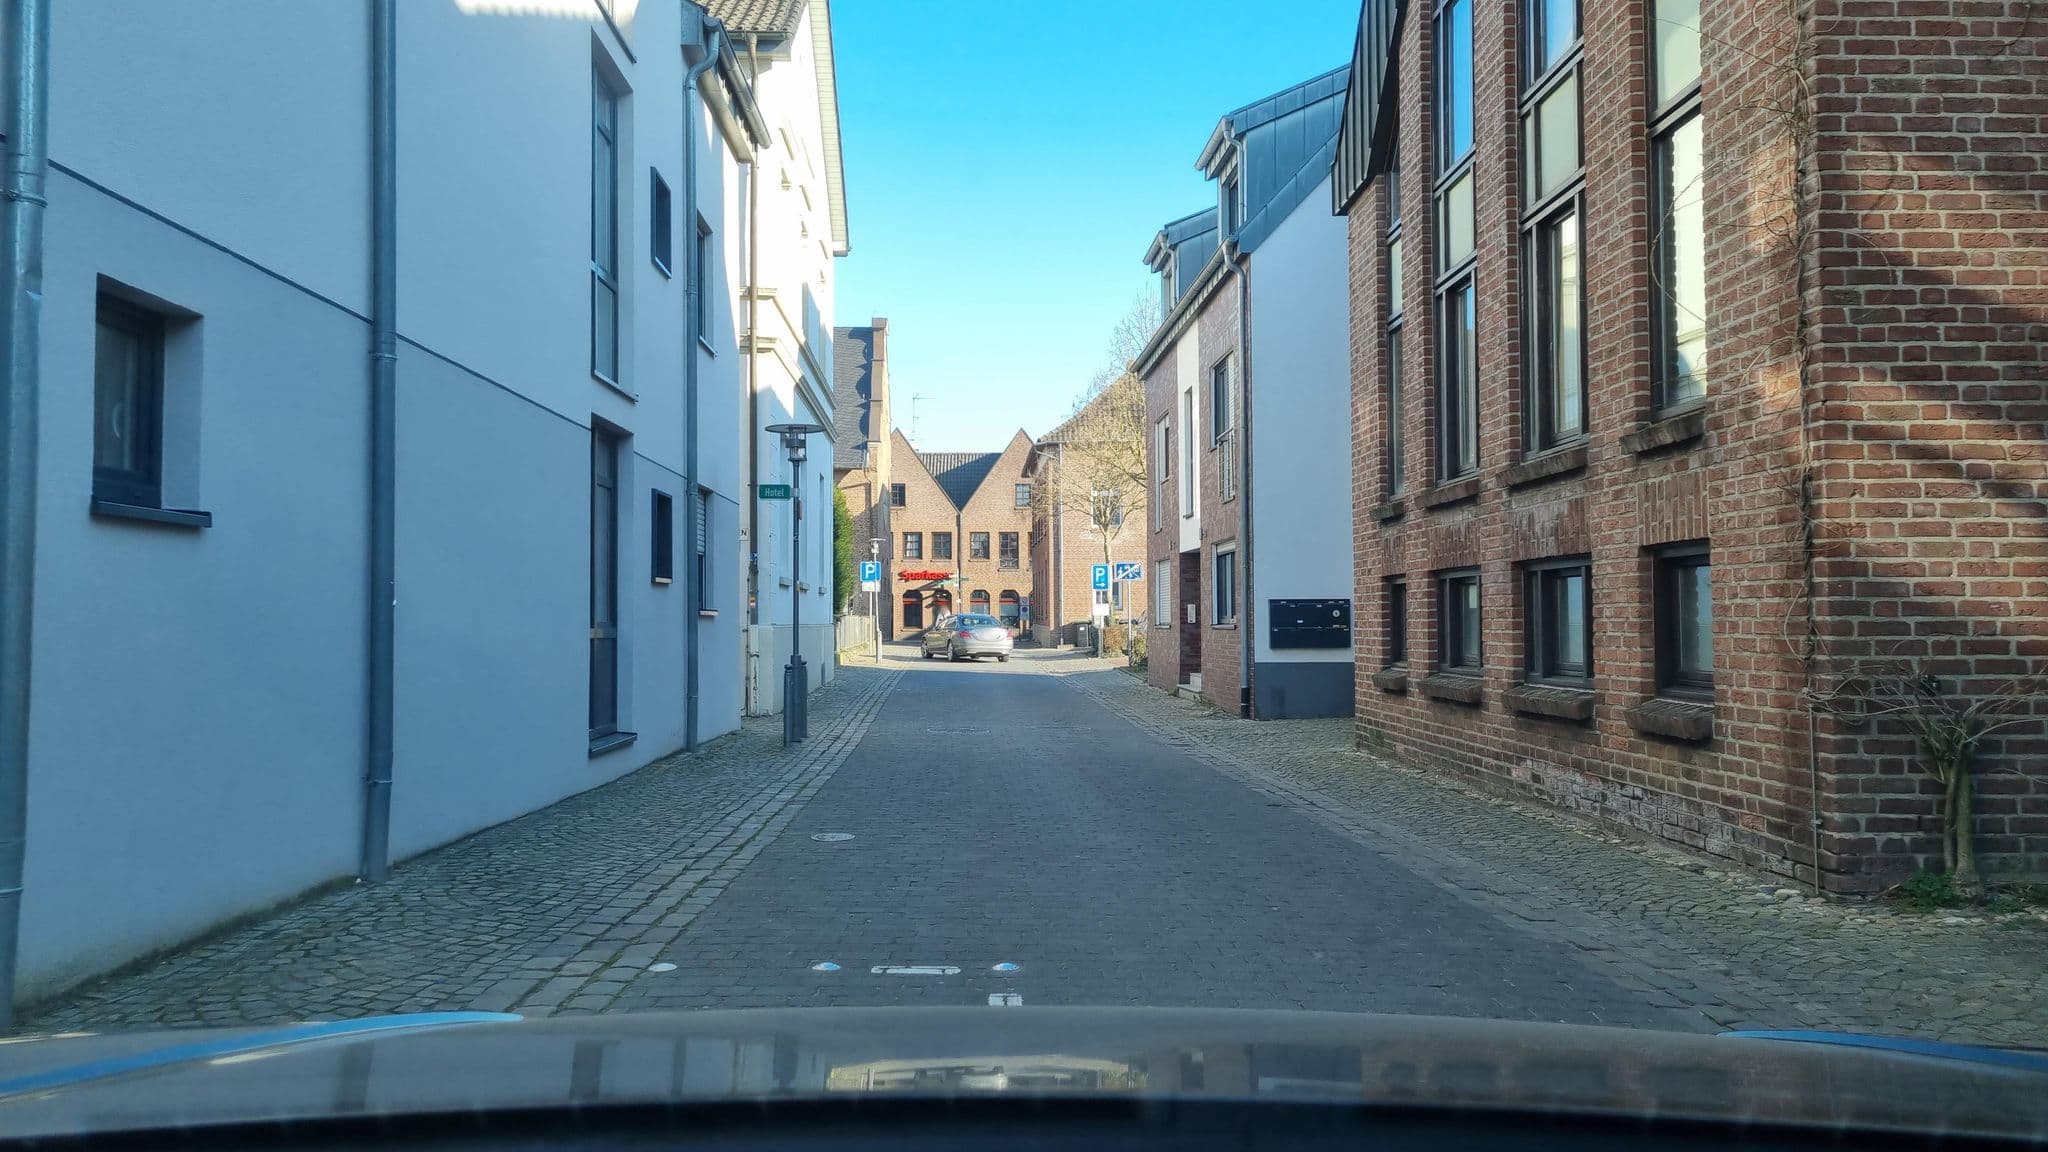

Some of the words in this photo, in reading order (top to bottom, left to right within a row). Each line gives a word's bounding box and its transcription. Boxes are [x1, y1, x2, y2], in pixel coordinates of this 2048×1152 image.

[764, 488, 784, 497] Hotel
[865, 564, 875, 579] P
[1095, 567, 1105, 582] P
